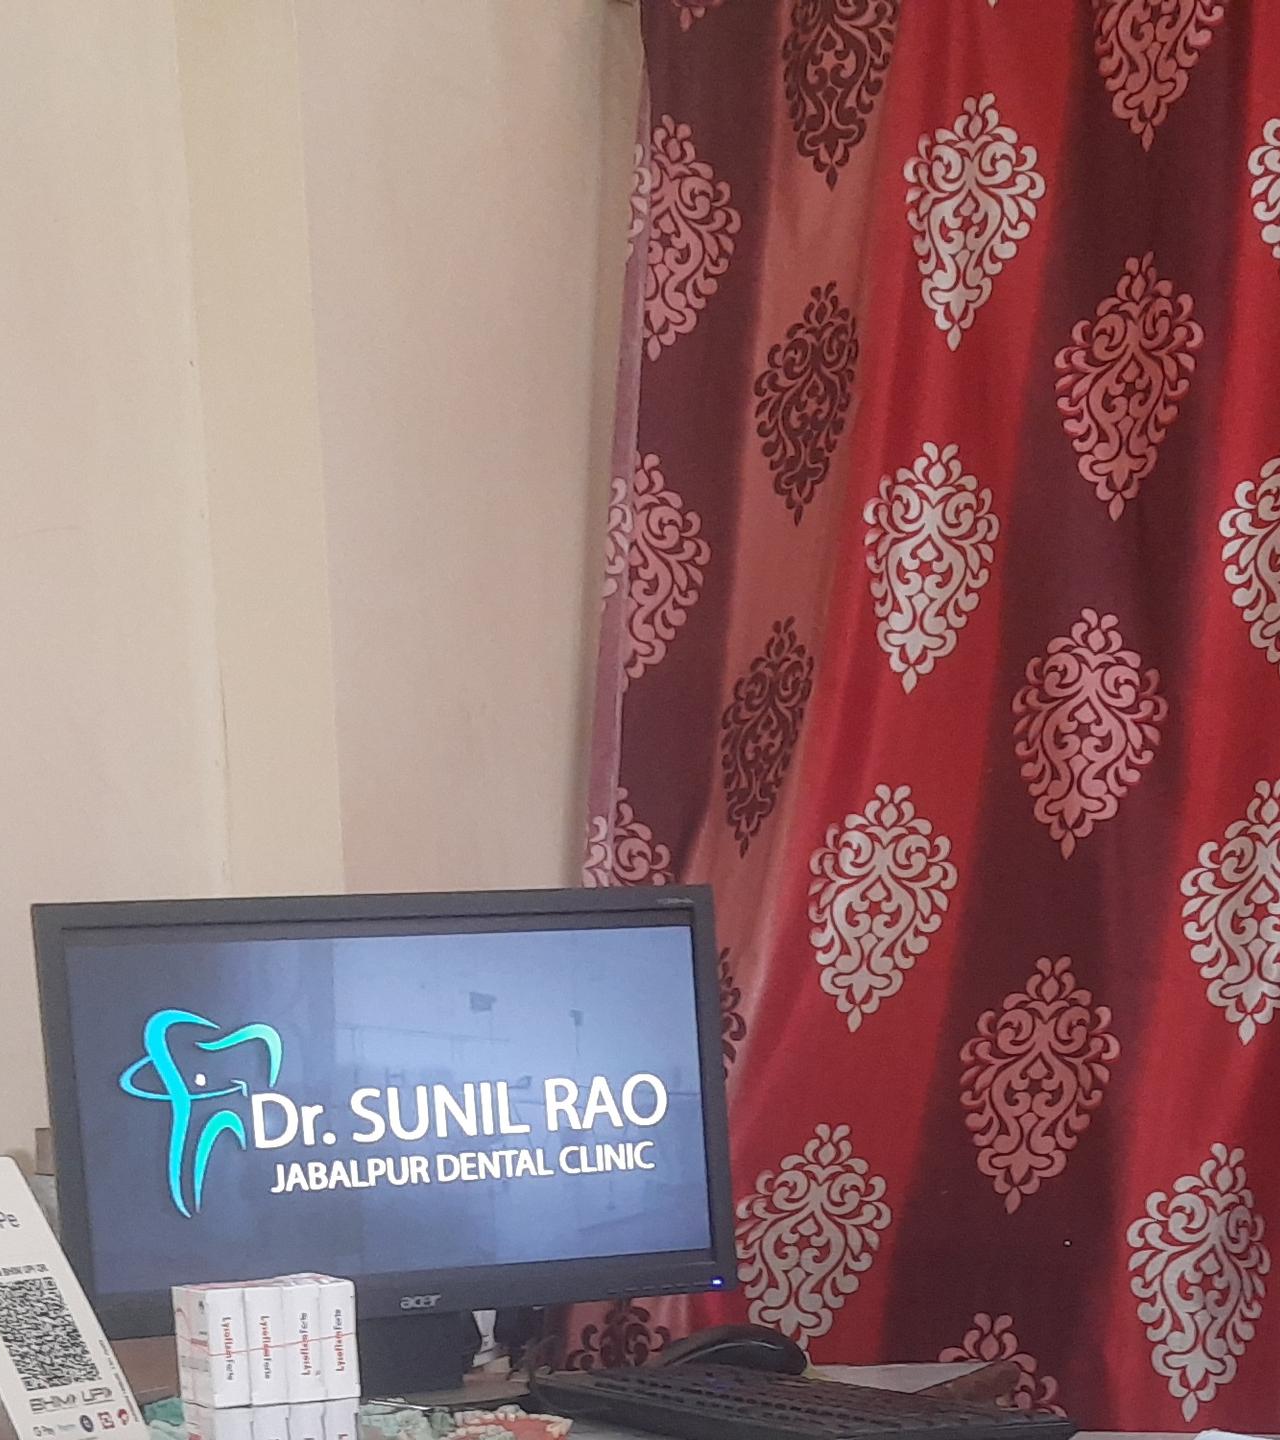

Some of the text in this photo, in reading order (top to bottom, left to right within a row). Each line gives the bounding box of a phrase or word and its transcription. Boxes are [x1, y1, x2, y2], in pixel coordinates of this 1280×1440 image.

[251, 1073, 668, 1149] Dr. SUNIL RAO
[270, 1140, 656, 1194] JABALPUR DENTAL CLINIC
[400, 1294, 441, 1309] acer
